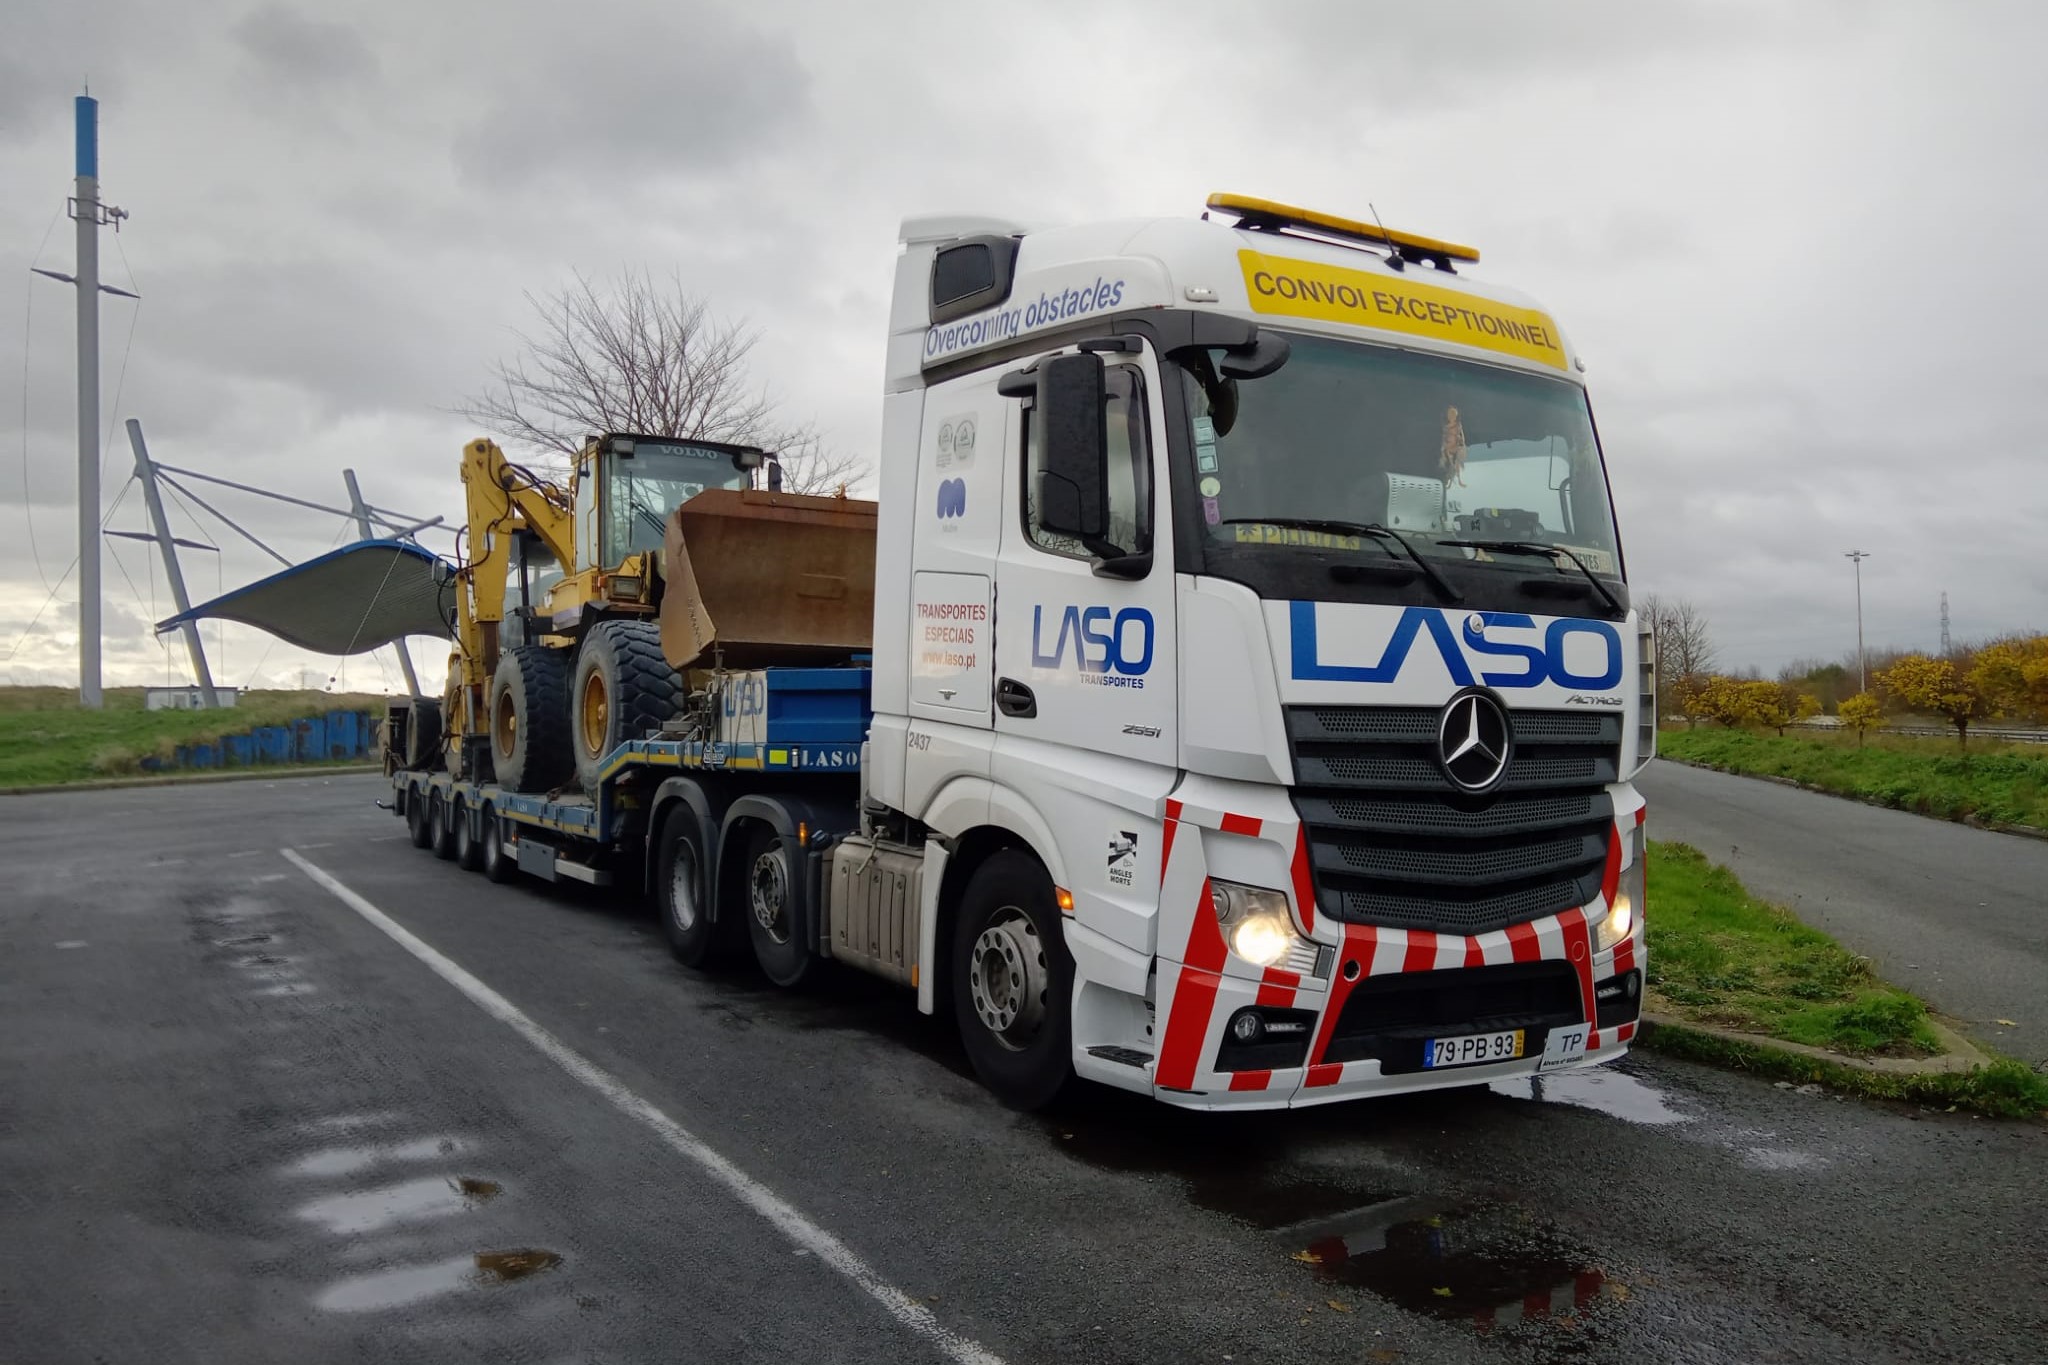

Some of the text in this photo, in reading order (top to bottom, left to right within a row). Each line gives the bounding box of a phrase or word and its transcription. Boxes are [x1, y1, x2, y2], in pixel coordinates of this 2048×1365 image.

[926, 276, 1125, 356] Overcoming obstacles
[1254, 271, 1558, 351] CONVOI EXCEPTIONNEL
[660, 445, 718, 460] VOLVO
[917, 603, 986, 621] TRANSPORTES
[925, 626, 975, 644] ESPECIAIS
[1031, 604, 1155, 676] LASO
[1289, 600, 1624, 691] LASO
[921, 650, 976, 671] www.laso.pt
[1080, 674, 1144, 689] TRANSPORTES
[908, 732, 931, 751] 2437
[801, 749, 858, 768] LASO
[1562, 1033, 1582, 1053] TP
